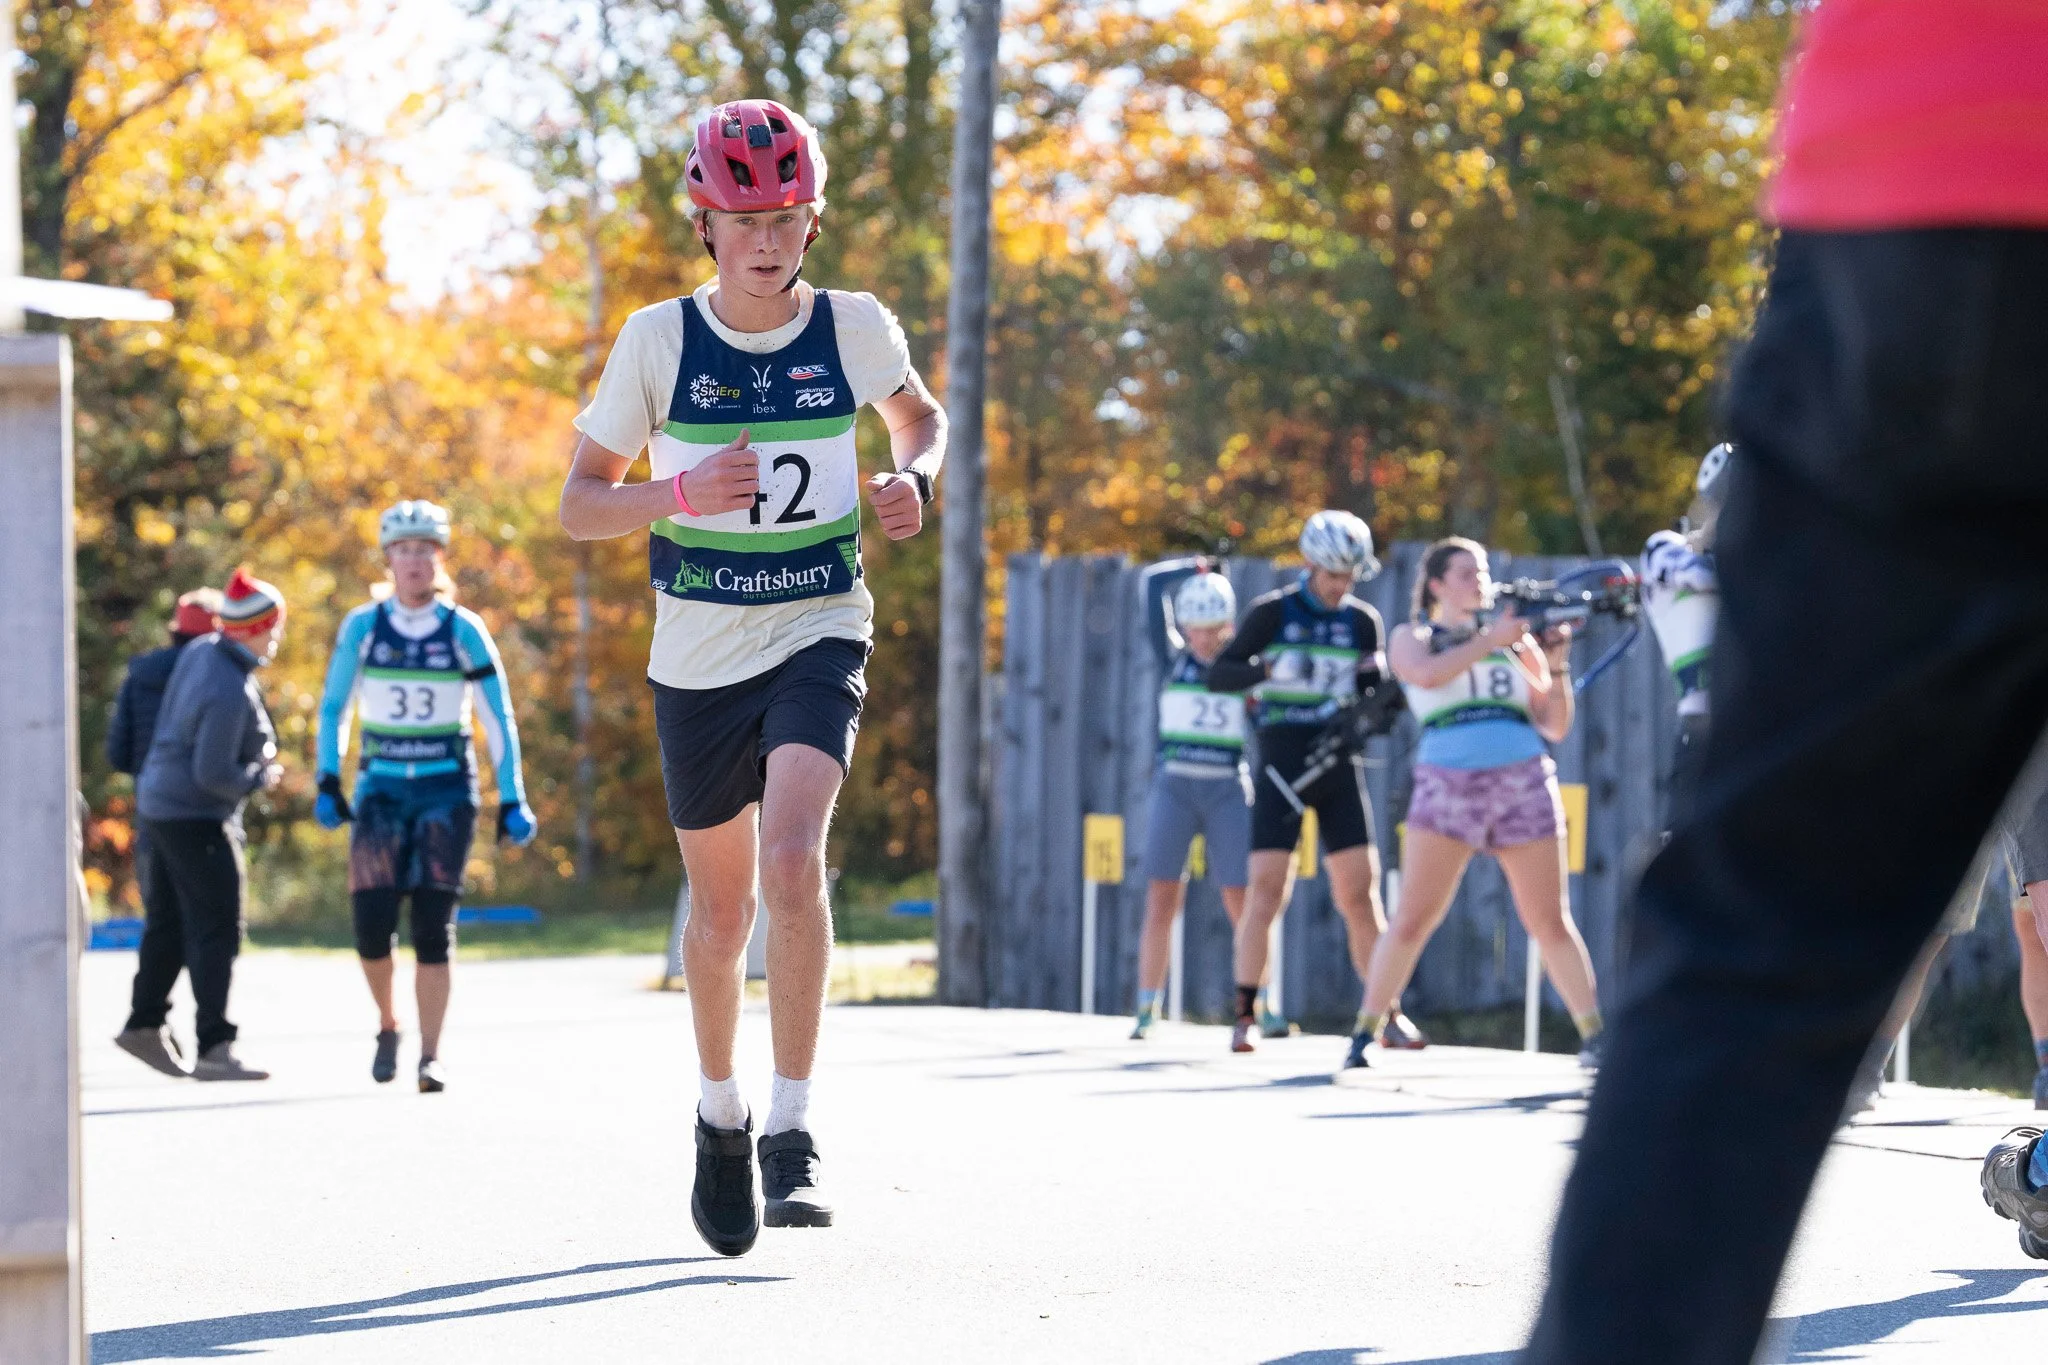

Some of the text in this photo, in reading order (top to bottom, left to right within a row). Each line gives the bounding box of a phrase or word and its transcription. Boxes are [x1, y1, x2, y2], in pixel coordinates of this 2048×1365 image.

[700, 386, 740, 398] SkiErg
[753, 404, 776, 413] ibex
[715, 564, 833, 592] Craftsbury
[743, 584, 821, 599] OUTDOOR CENTER
[1468, 666, 1514, 699] 18
[388, 685, 435, 721] 33
[1193, 696, 1229, 731] 25
